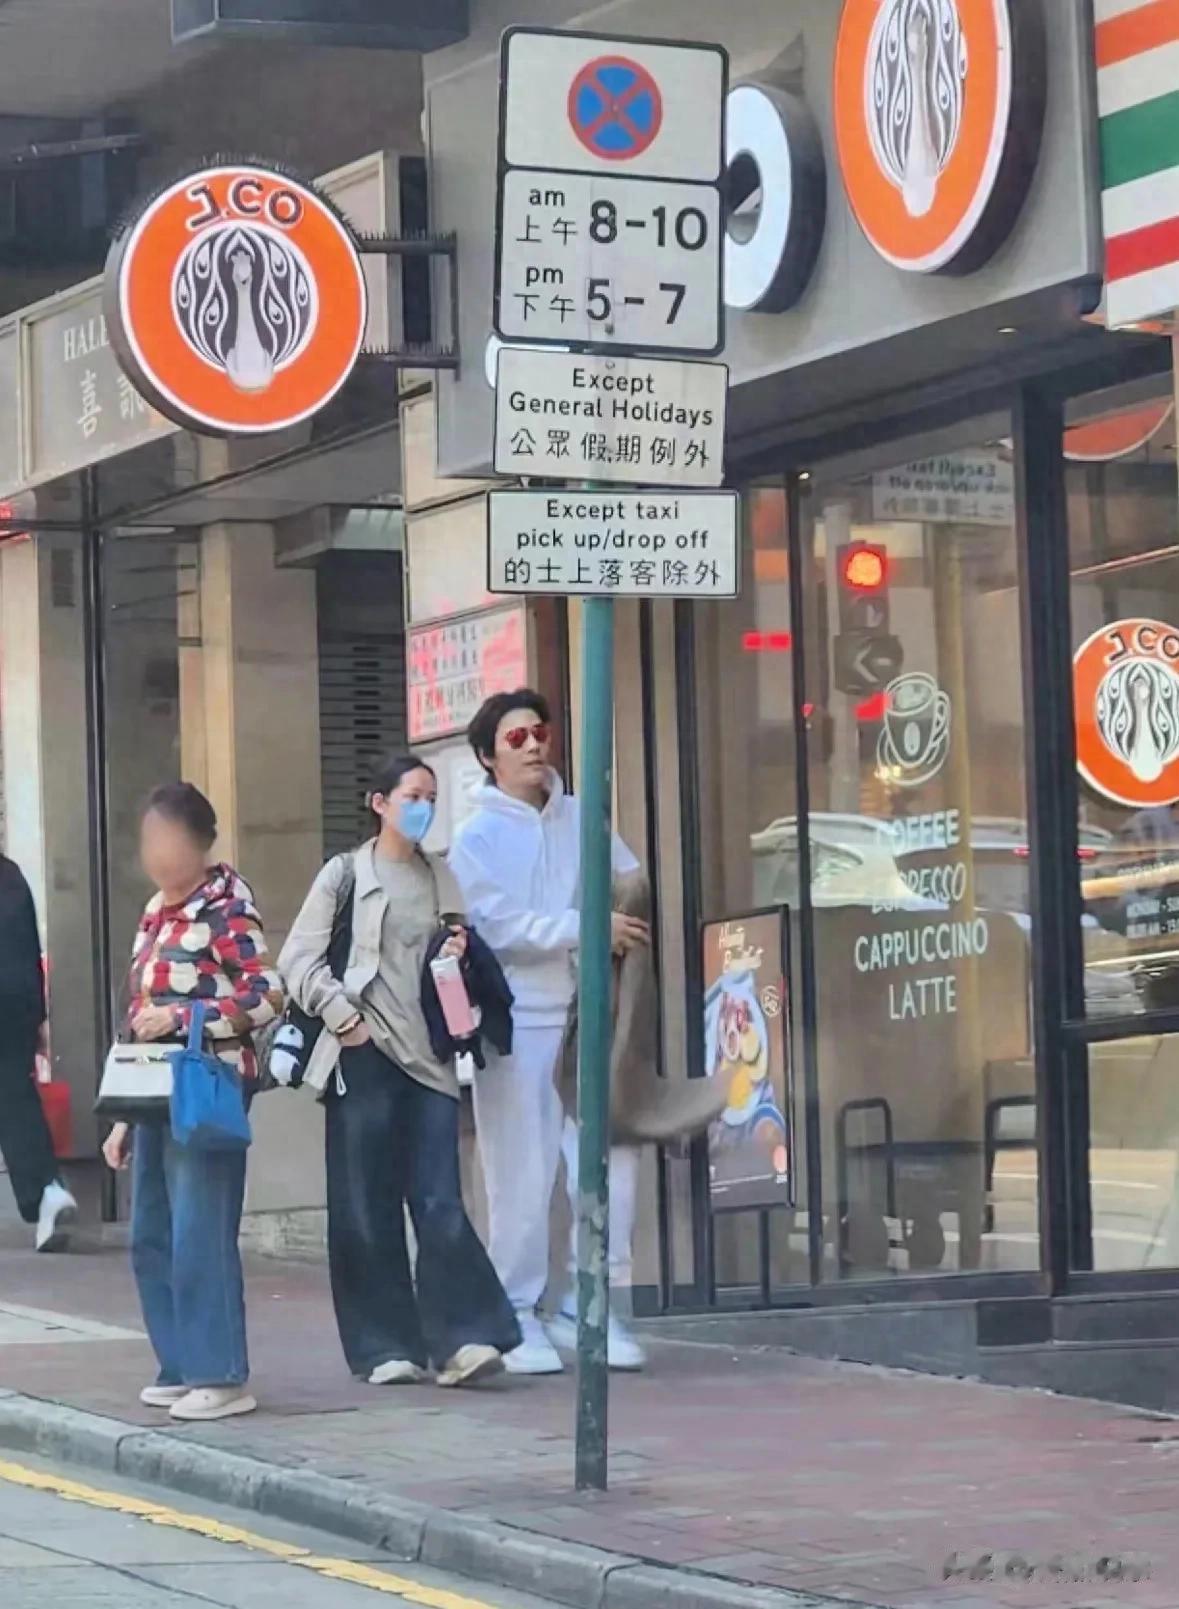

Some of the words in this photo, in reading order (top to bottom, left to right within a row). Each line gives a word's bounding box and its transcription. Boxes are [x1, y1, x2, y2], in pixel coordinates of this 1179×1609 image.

[187, 177, 303, 229] J.CO
[529, 189, 566, 207] am
[515, 214, 578, 246] 上午
[589, 200, 708, 251] 8-10
[525, 266, 564, 287] pm
[513, 293, 576, 324] 下午
[573, 367, 656, 396] Except
[509, 391, 603, 418] General
[612, 399, 713, 429] Holidays
[510, 428, 710, 468] 公眾假期例外
[546, 499, 626, 522] Except
[636, 501, 679, 520] taxi
[516, 528, 564, 550] pick
[574, 529, 666, 551] up/drop
[675, 530, 710, 549] off
[504, 557, 721, 588] 的士上落客除外
[883, 809, 960, 848] OFFEE
[872, 862, 966, 914] RESSO
[854, 918, 988, 972] CAPPUCCINO
[889, 976, 957, 1020] LATTE
